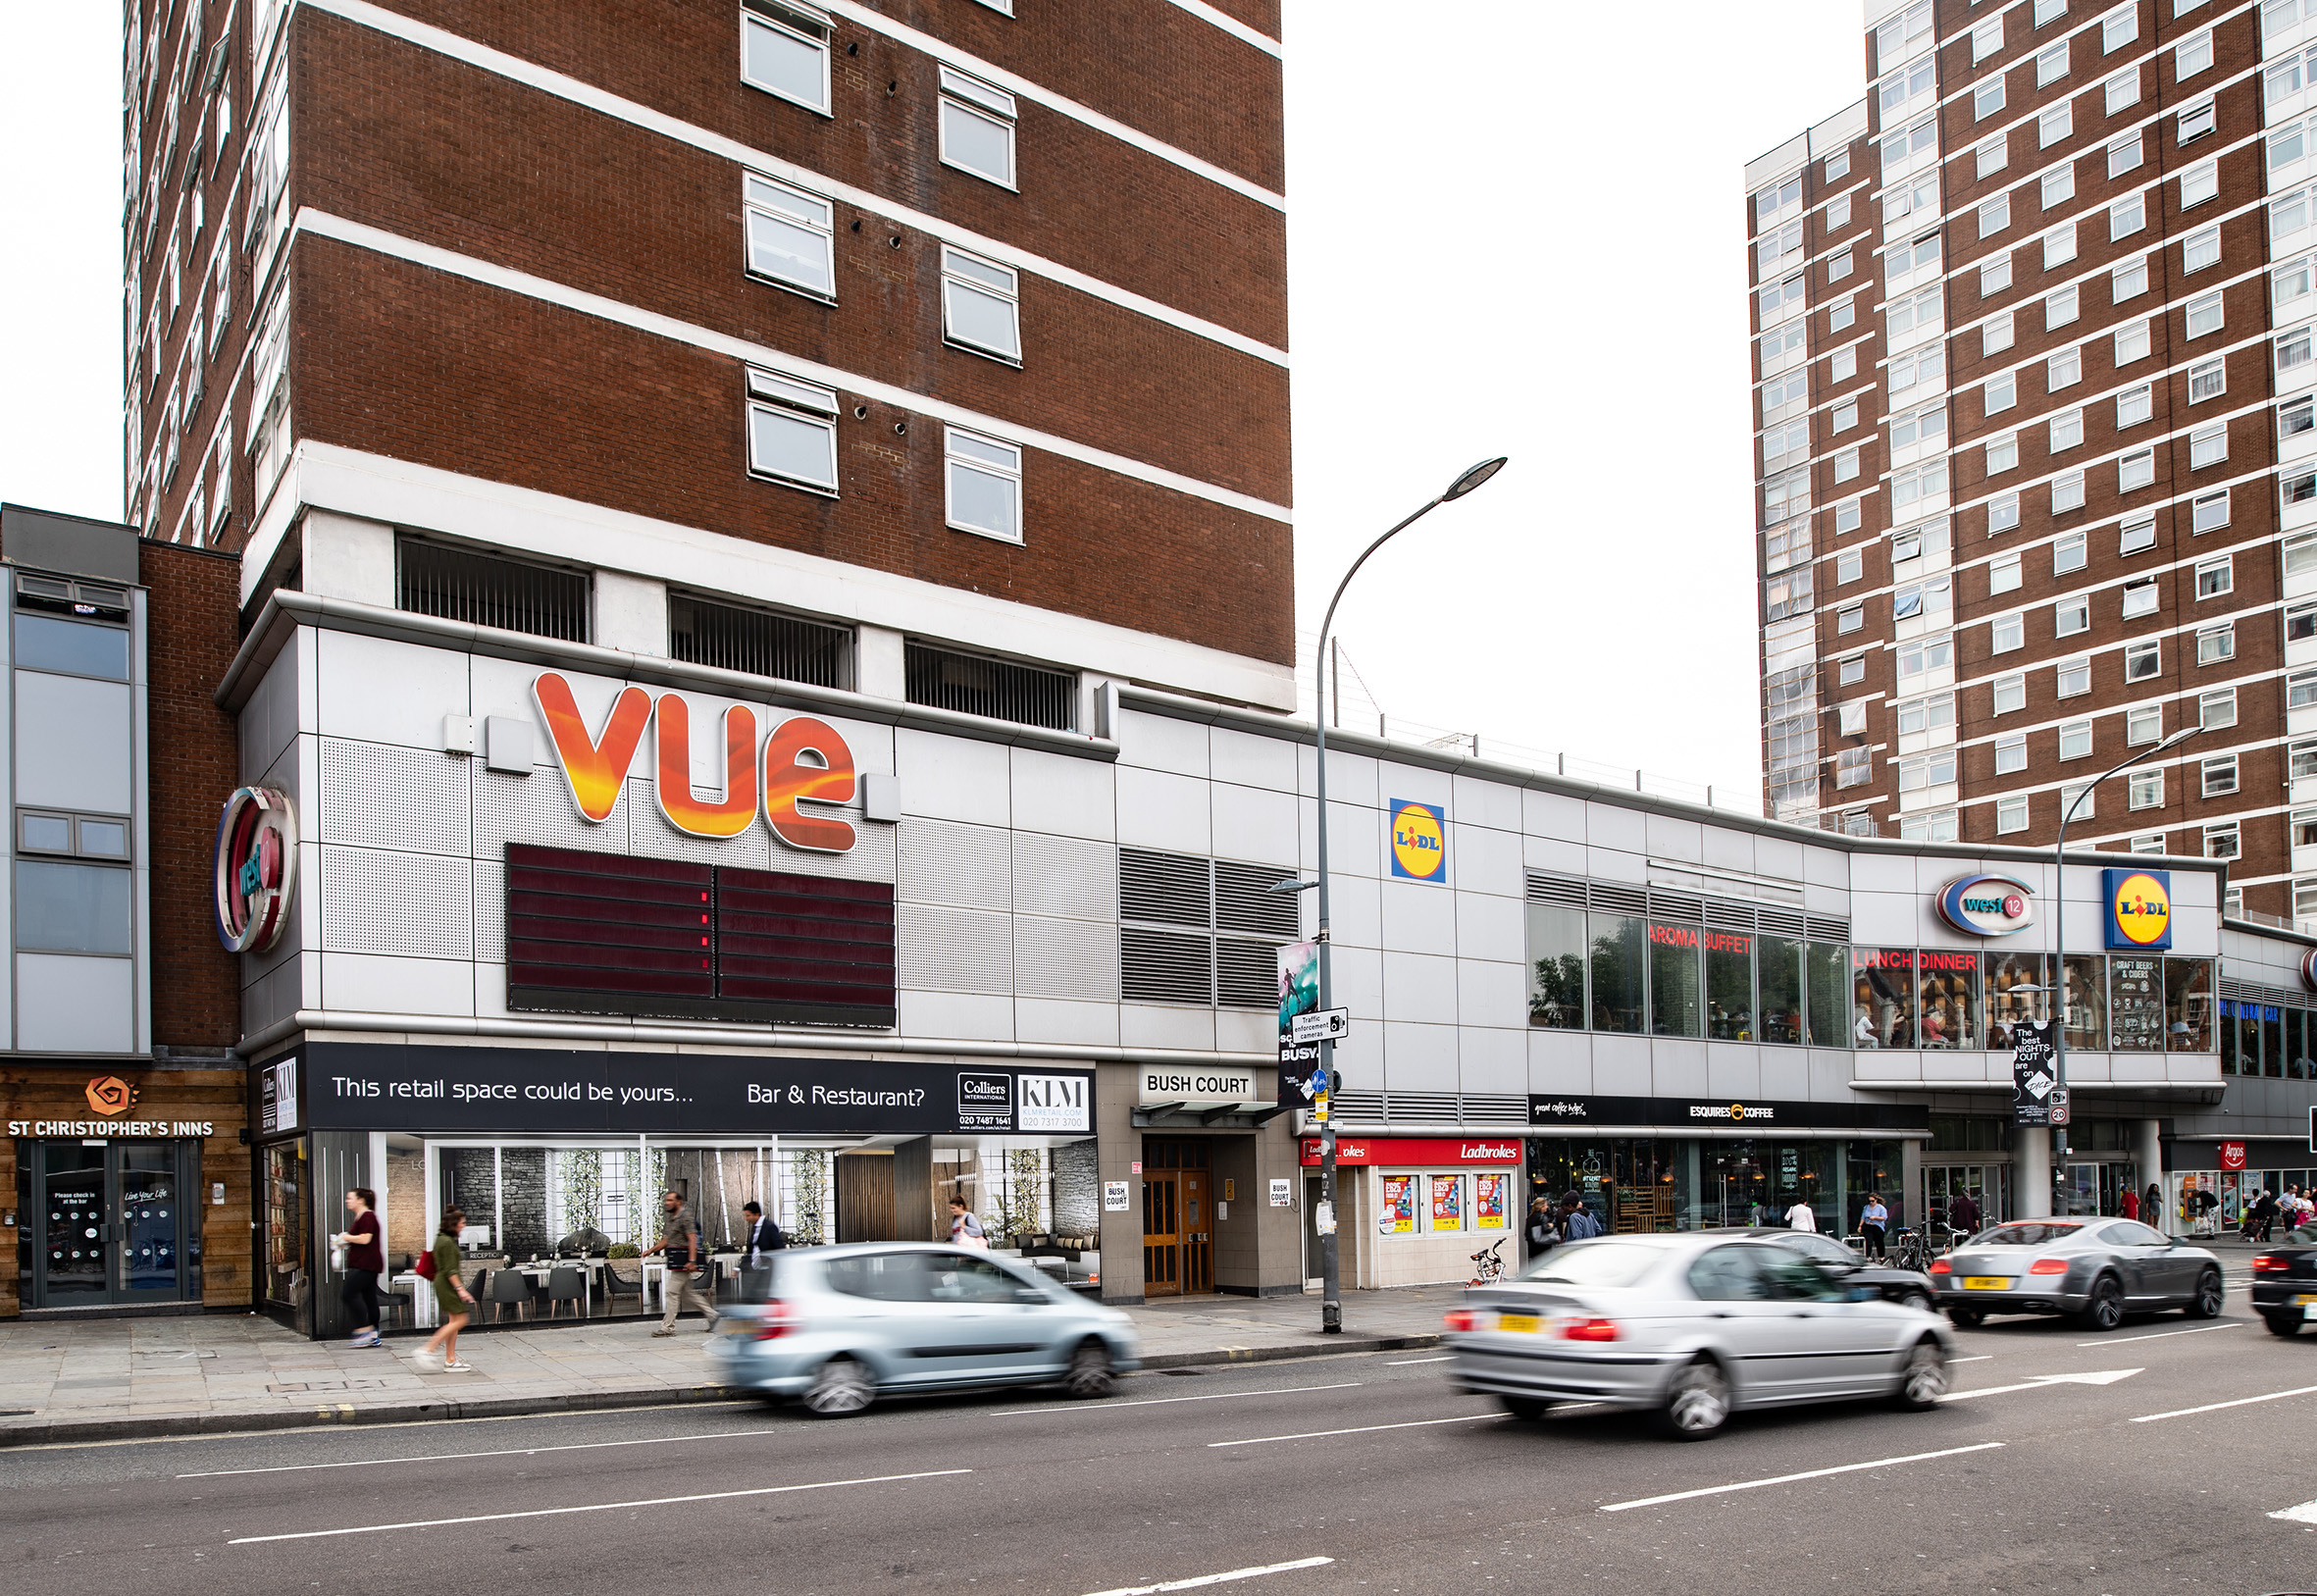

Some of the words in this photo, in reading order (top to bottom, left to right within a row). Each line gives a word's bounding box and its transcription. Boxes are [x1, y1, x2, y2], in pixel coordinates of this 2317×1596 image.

[1965, 897, 2003, 913] west
[2008, 900, 2021, 913] 12
[1649, 924, 1699, 948] AROMA
[1705, 932, 1751, 954] BUFFET
[1853, 951, 1913, 968] LUNCH
[1919, 952, 1978, 970] DINNER
[2116, 960, 2135, 969] CRAFT
[2136, 961, 2153, 970] BEERS
[2122, 969, 2128, 978] &
[2129, 970, 2148, 979] CIDERS
[2232, 1001, 2259, 1019] CNTRA
[2265, 1006, 2278, 1022] BAR
[1302, 1015, 1320, 1024] Traffic
[1295, 1022, 1329, 1033] enforcement
[1300, 1031, 1323, 1040] cameras
[2022, 1036, 2040, 1045] best
[2015, 1044, 2050, 1054] NIGHTS
[2020, 1053, 2039, 1061] OUT
[964, 1080, 1006, 1095] Colliers
[1147, 1075, 1191, 1092] BUSH
[1196, 1077, 1249, 1093] COURT
[332, 1077, 381, 1097] This
[389, 1079, 443, 1098] retail
[452, 1083, 517, 1104] space
[525, 1082, 581, 1101] could
[589, 1082, 614, 1101] be
[620, 1086, 694, 1106] yours...
[747, 1084, 782, 1104] Bar
[788, 1084, 805, 1104] &
[812, 1085, 925, 1107] Restaurant?
[1021, 1079, 1083, 1107] KLM
[1689, 1106, 1731, 1118] ESQUIRES
[1743, 1107, 1775, 1118] COFFEE
[958, 1115, 974, 1125] 020
[976, 1116, 994, 1125] 7487
[996, 1116, 1011, 1125] 1641
[1022, 1117, 1039, 1127] 020
[1041, 1117, 1059, 1127] 7317
[1062, 1117, 1082, 1127] 3700
[8, 1121, 30, 1136] ST
[174, 1121, 213, 1136] INNS
[1461, 1144, 1518, 1158] Ladbrokes
[2225, 1144, 2244, 1161] Argos
[1385, 1182, 1401, 1193] £625
[1433, 1181, 1449, 1192] £625
[1478, 1180, 1493, 1191] £625
[125, 1191, 138, 1201] Live
[139, 1190, 154, 1202] Your
[155, 1188, 168, 1199] Life
[1108, 1187, 1125, 1196] BUSH
[1106, 1197, 1127, 1206] COURT
